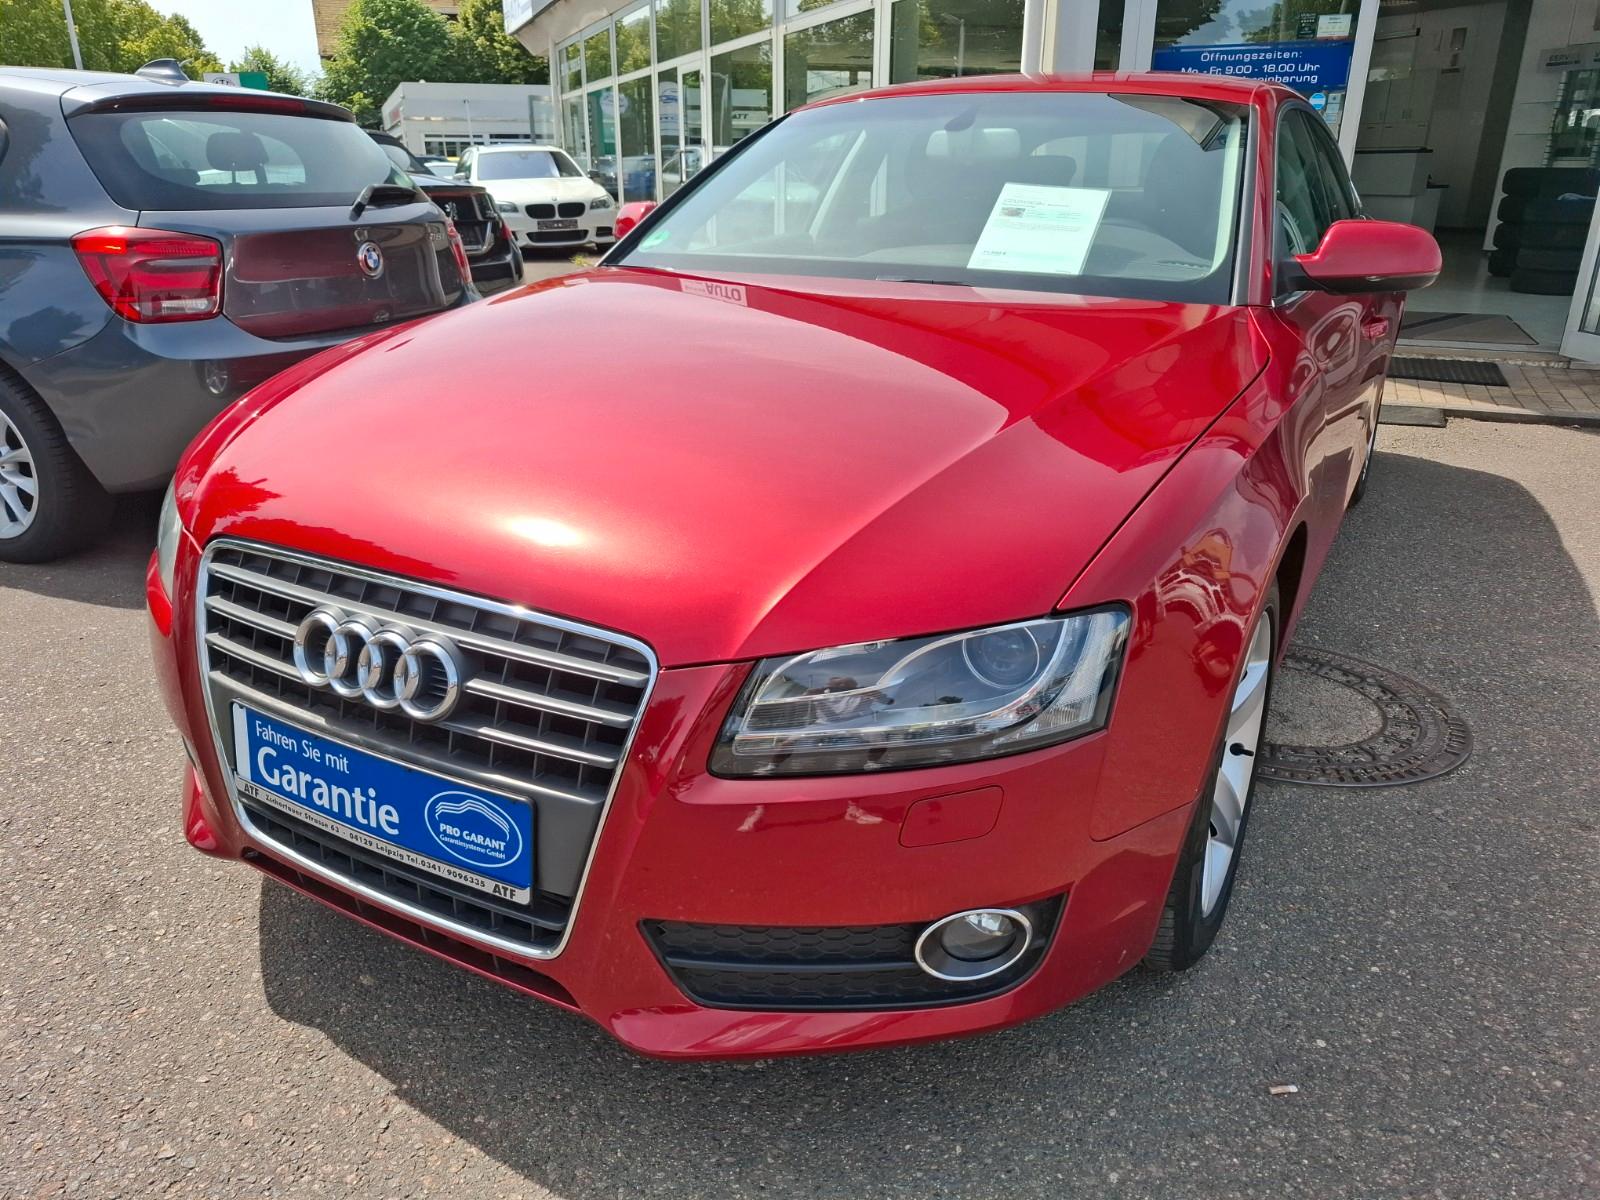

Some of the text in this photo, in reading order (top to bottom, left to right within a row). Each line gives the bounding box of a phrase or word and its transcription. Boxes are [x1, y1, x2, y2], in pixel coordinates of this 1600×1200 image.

[1200, 51, 1303, 62] Öffnungszeiten:
[1225, 65, 1252, 75] 9.00
[1262, 63, 1295, 73] 18.00
[1298, 62, 1320, 72] Uhr
[255, 719, 350, 774] Fahren Sie mit
[257, 746, 400, 835] Garantie
[244, 783, 260, 798] ATF
[349, 832, 373, 847] 04129
[375, 842, 405, 861] Leipzig
[492, 883, 517, 900] ATF
[440, 822, 506, 851] PRO GARANT
